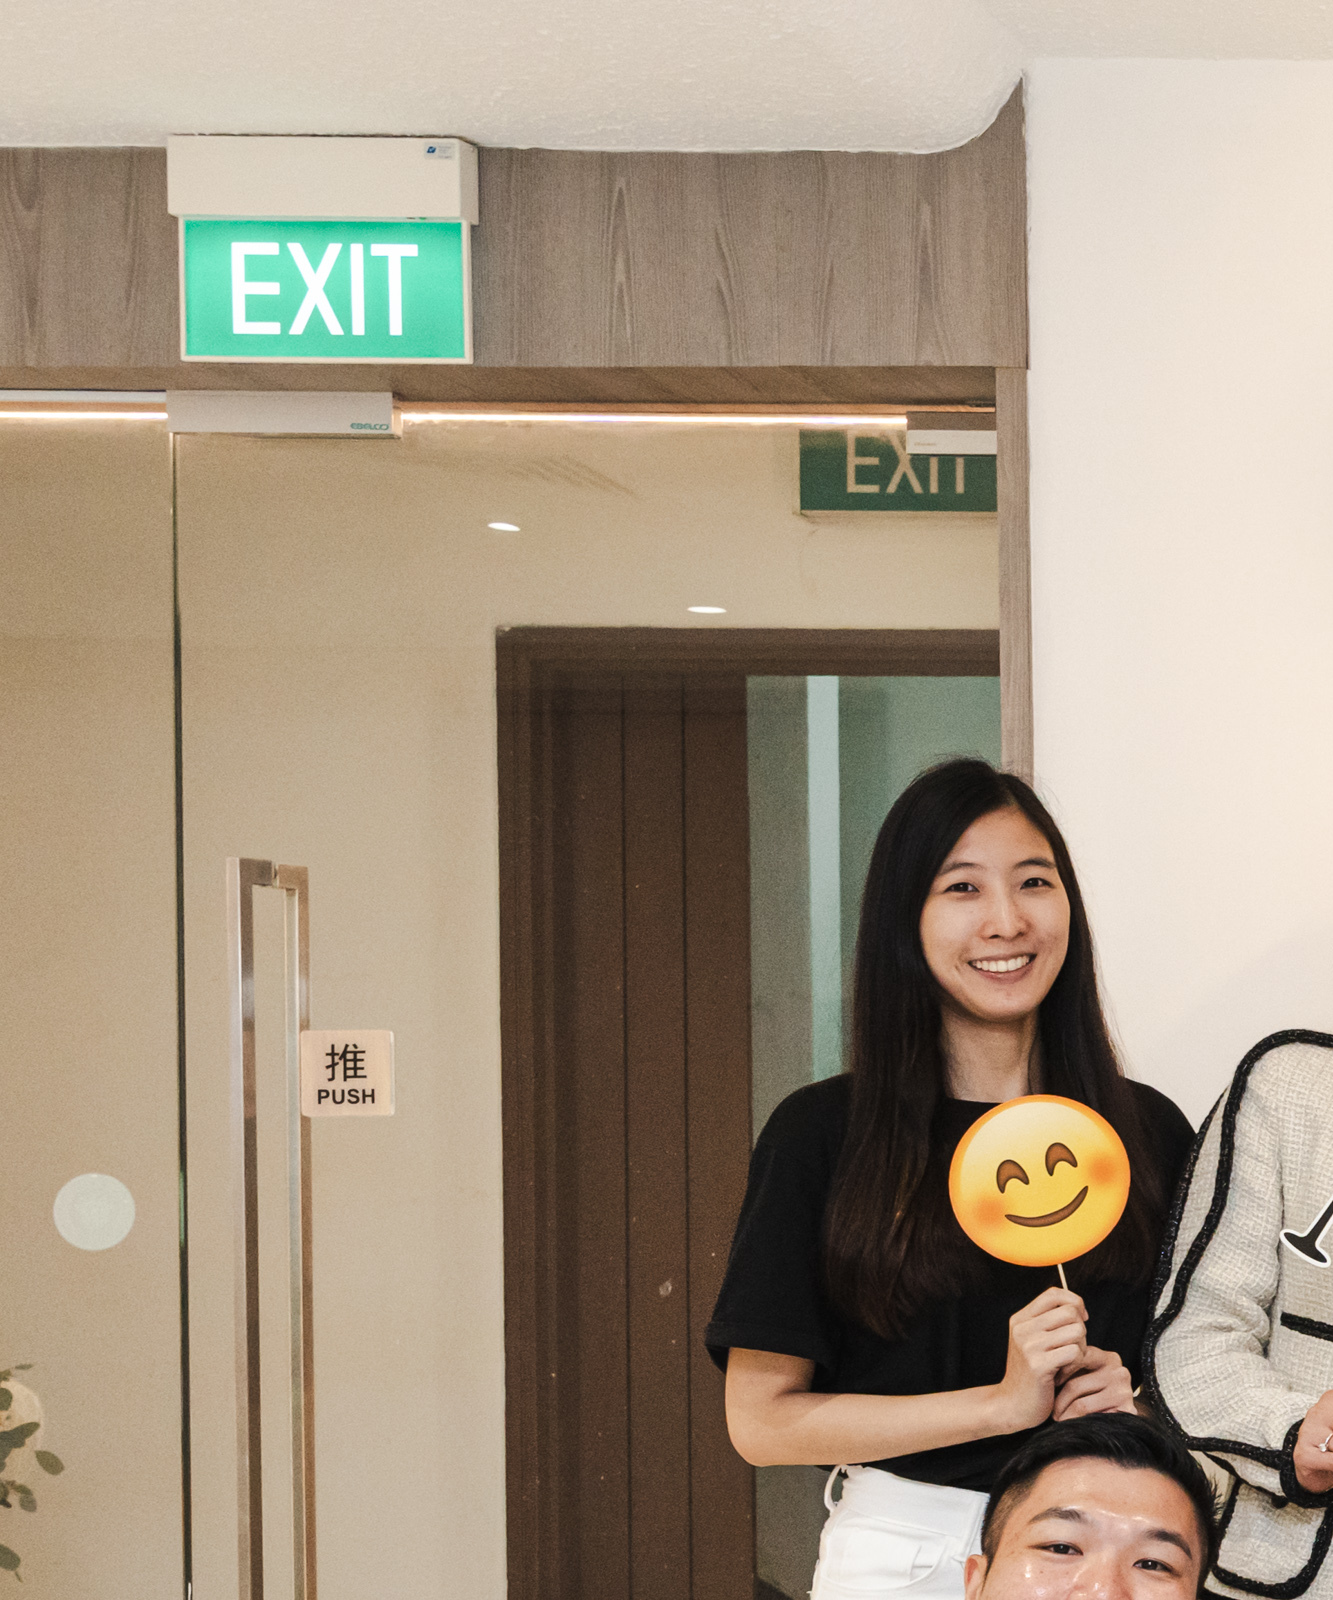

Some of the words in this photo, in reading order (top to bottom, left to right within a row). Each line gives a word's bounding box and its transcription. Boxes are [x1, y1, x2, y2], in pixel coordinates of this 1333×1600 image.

[231, 242, 419, 336] EXIT
[325, 1043, 367, 1082] 推
[317, 1088, 375, 1105] PUSH
